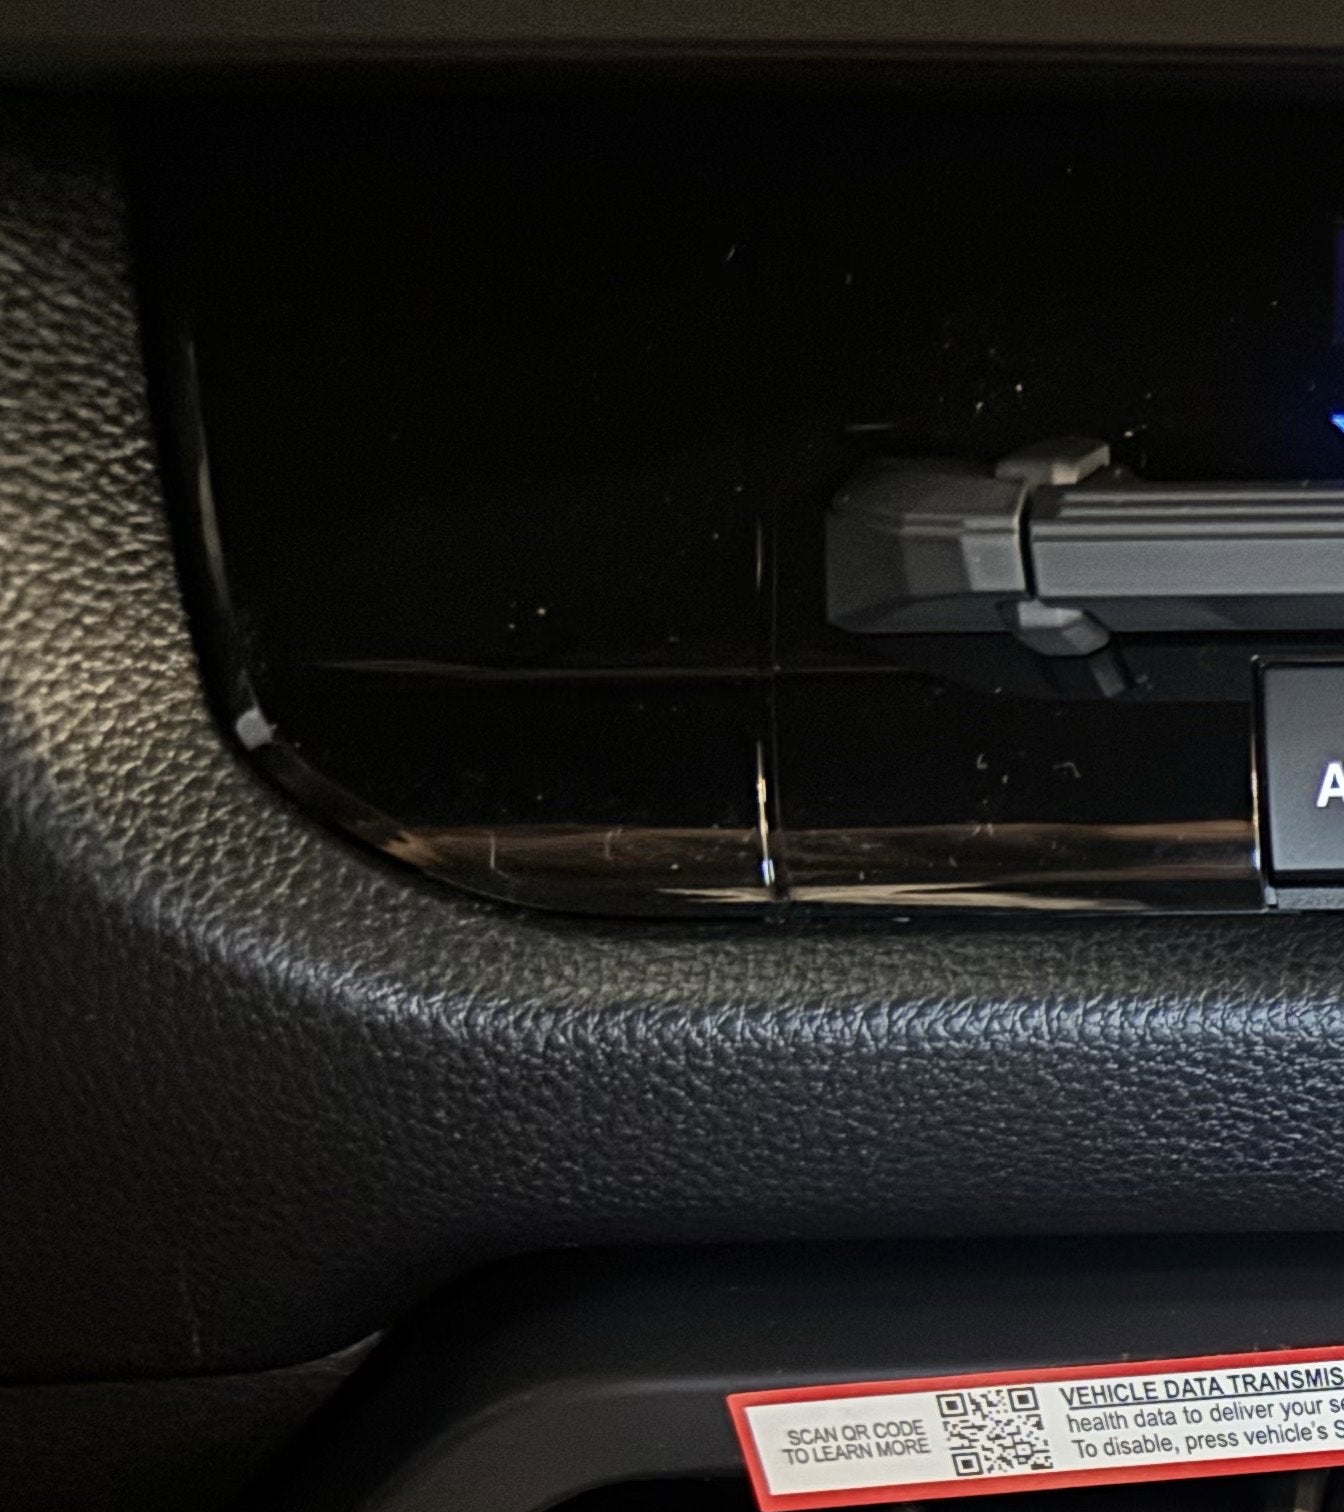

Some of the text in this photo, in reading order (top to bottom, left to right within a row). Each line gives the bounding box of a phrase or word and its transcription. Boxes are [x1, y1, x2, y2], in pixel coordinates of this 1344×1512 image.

[1059, 1380, 1158, 1407] VEHICLE
[1164, 1376, 1224, 1399] DATA
[1066, 1406, 1128, 1433] health
[1134, 1404, 1177, 1428] data
[1183, 1406, 1203, 1425] to
[1210, 1396, 1274, 1422] deliver
[1279, 1398, 1323, 1421] your
[787, 1419, 927, 1446] SCAN QR CODE
[1072, 1439, 1098, 1459] To
[1103, 1430, 1180, 1457] disable,
[1185, 1431, 1239, 1455] press
[1244, 1420, 1328, 1446] vehicle's
[782, 1437, 931, 1465] TO LEARN MORE
